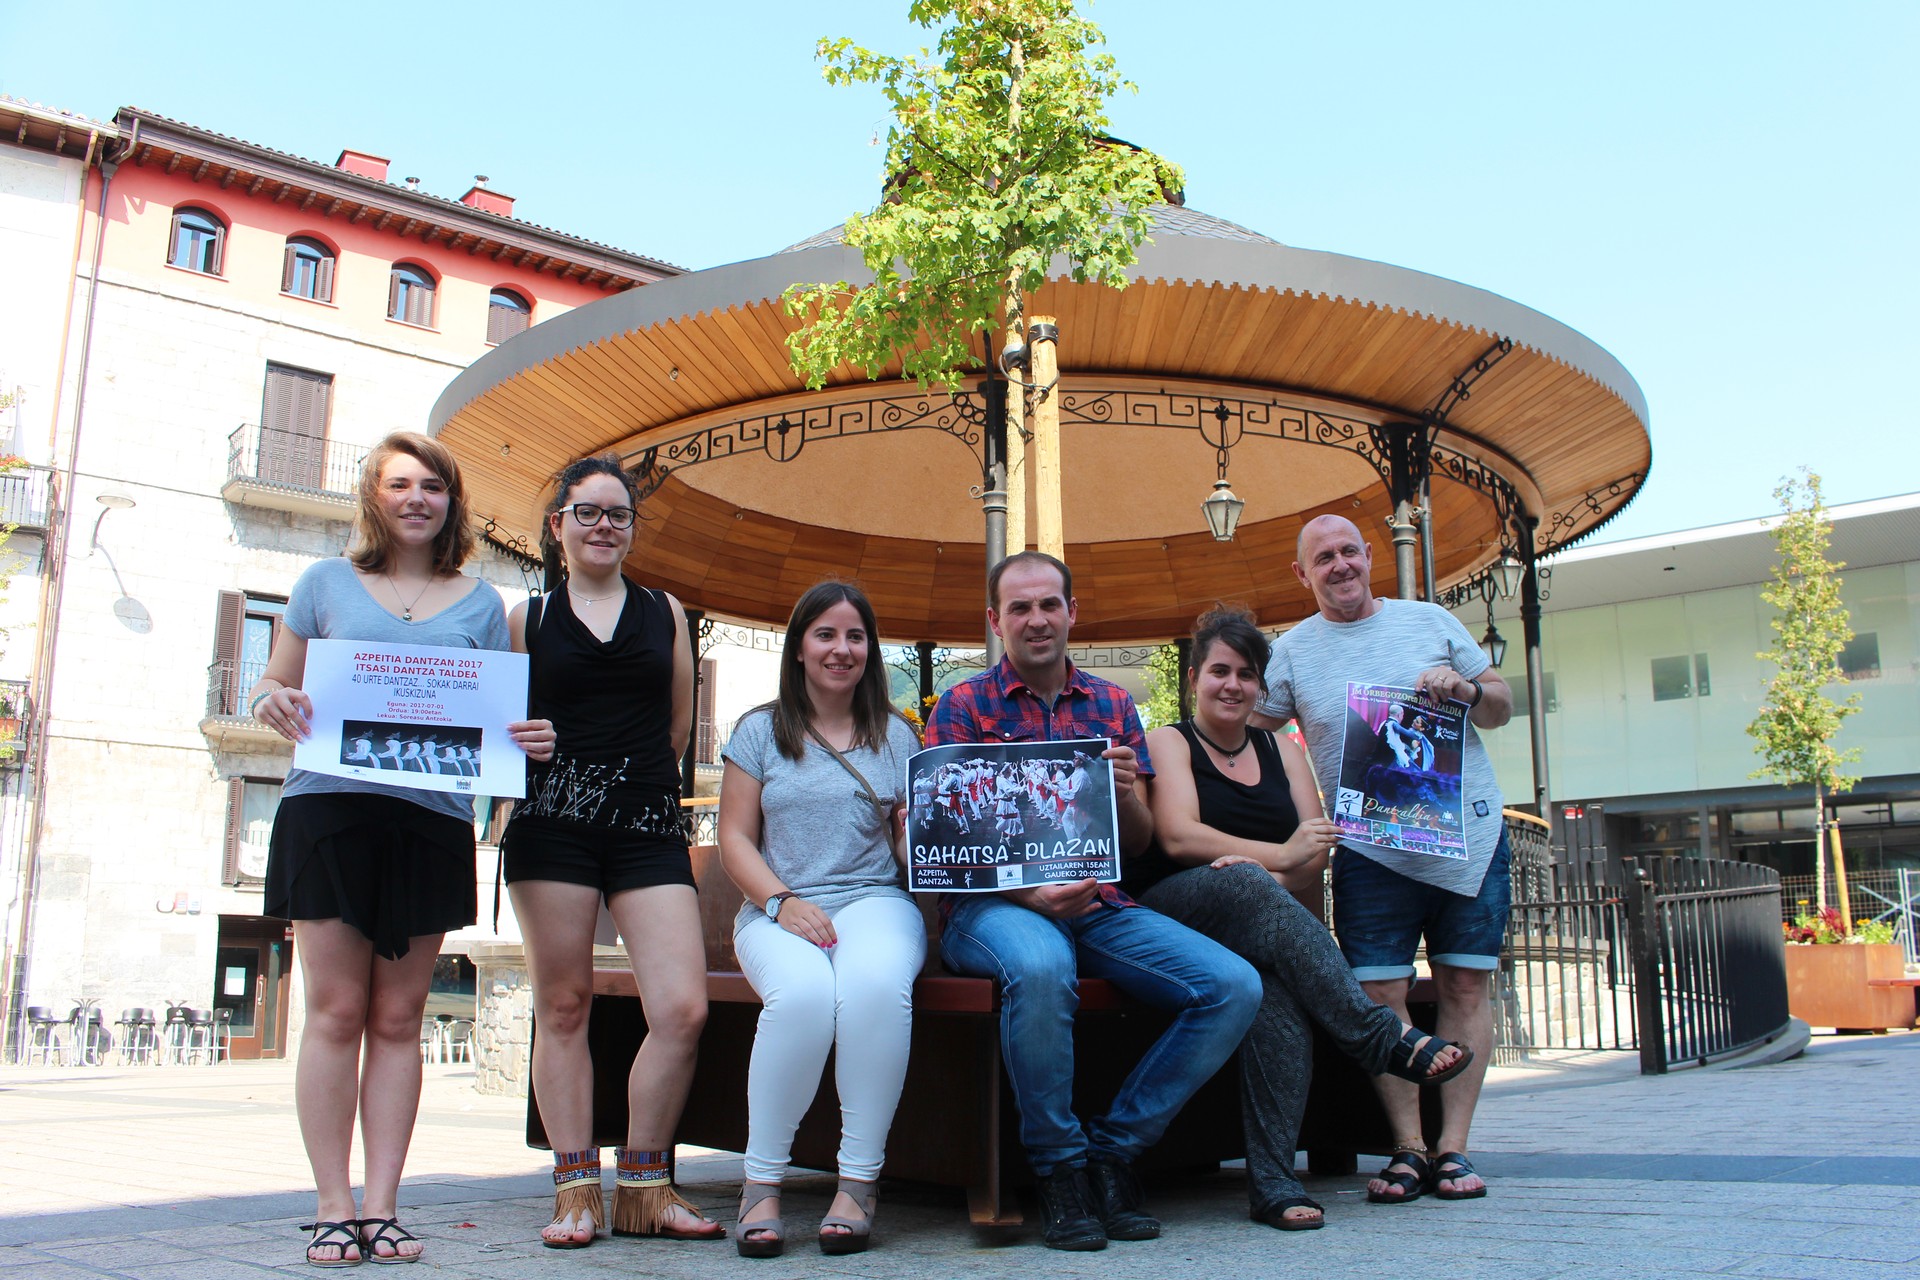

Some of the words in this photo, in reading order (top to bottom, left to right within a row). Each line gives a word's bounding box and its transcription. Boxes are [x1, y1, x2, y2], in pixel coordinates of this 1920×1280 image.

[354, 653, 402, 663] AZPEITIA
[405, 656, 455, 667] DANTZAN
[458, 660, 483, 669] 2017
[356, 664, 390, 673] ITSASI
[393, 666, 436, 676] DANTZA
[439, 669, 478, 679] TALDEA
[352, 674, 362, 683] 40
[363, 675, 382, 685] URTE
[426, 679, 451, 689] SOKAK
[452, 680, 479, 691] DARRAI
[393, 688, 437, 699] IKUSKIZUNA
[1351, 688, 1362, 696] JM
[1363, 797, 1431, 821] Dantzaldia
[914, 845, 1009, 865] SAHATSA
[1025, 838, 1111, 861] PLAZAN
[1039, 862, 1085, 872] UZTAILAREN
[1086, 861, 1110, 869] 15EAN
[917, 869, 948, 877] AZPEITIA
[1044, 871, 1077, 879] GAUEKO
[1078, 869, 1111, 878] 20:00AN
[917, 878, 953, 886] DANTZAN
